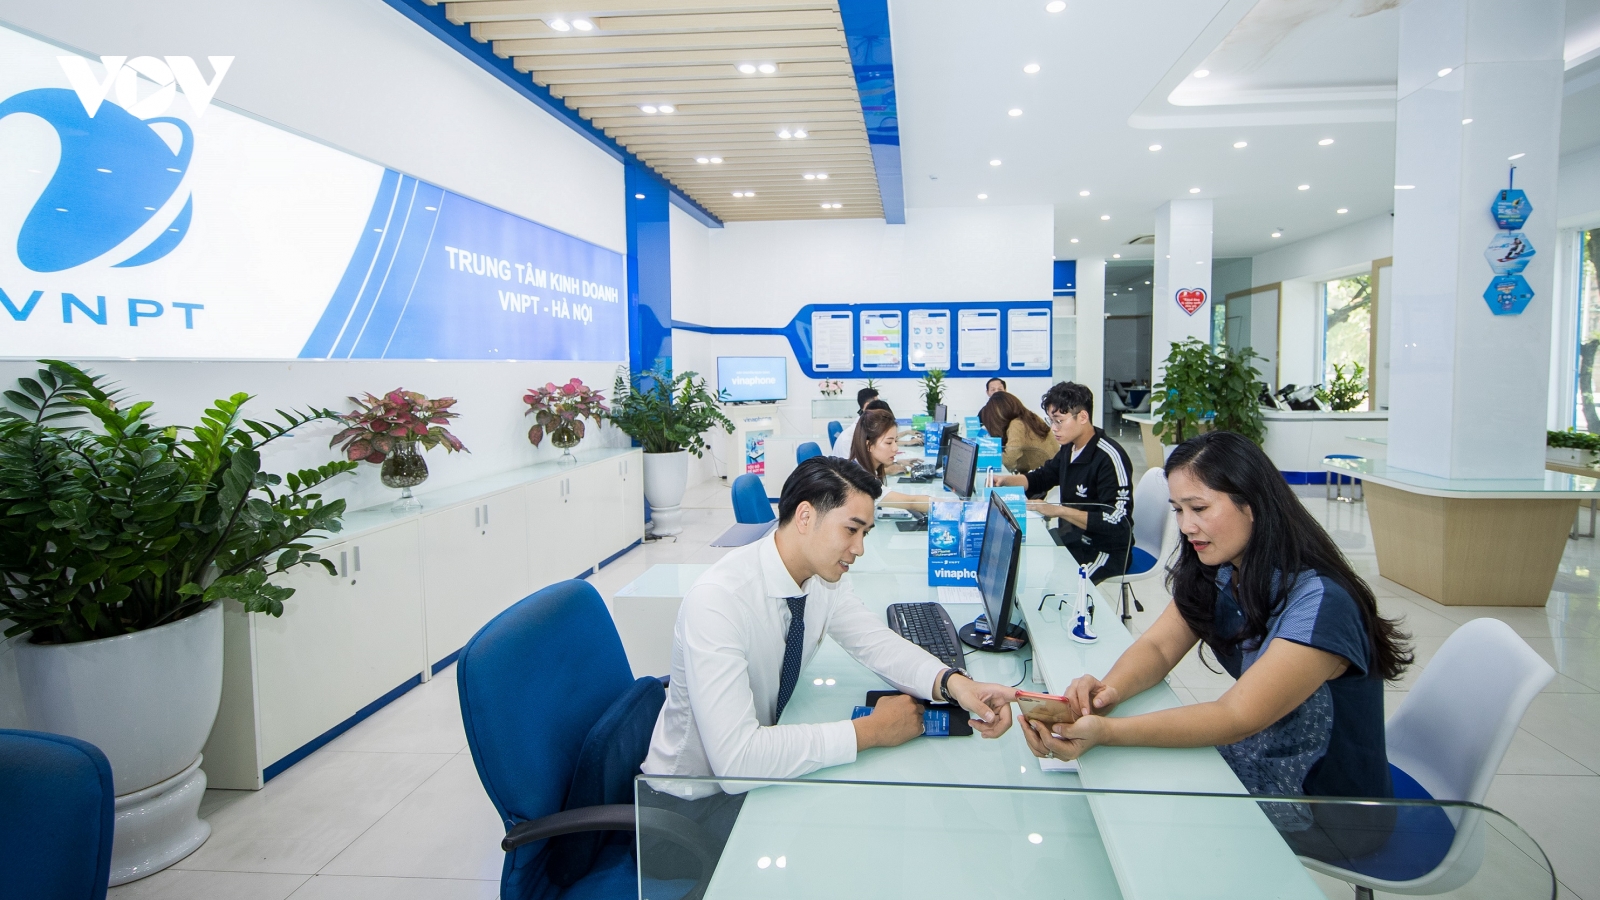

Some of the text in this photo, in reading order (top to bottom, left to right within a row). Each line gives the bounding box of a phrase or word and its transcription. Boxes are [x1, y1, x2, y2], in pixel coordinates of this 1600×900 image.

[445, 246, 619, 304] TRUNG TÂM KINH DOANH
[0, 287, 204, 330] VNPT
[498, 290, 540, 315] VNPT
[551, 298, 570, 319] HÀ
[573, 303, 593, 326] NỘI
[731, 376, 776, 386] vinaphone
[934, 567, 977, 580] vinapho
